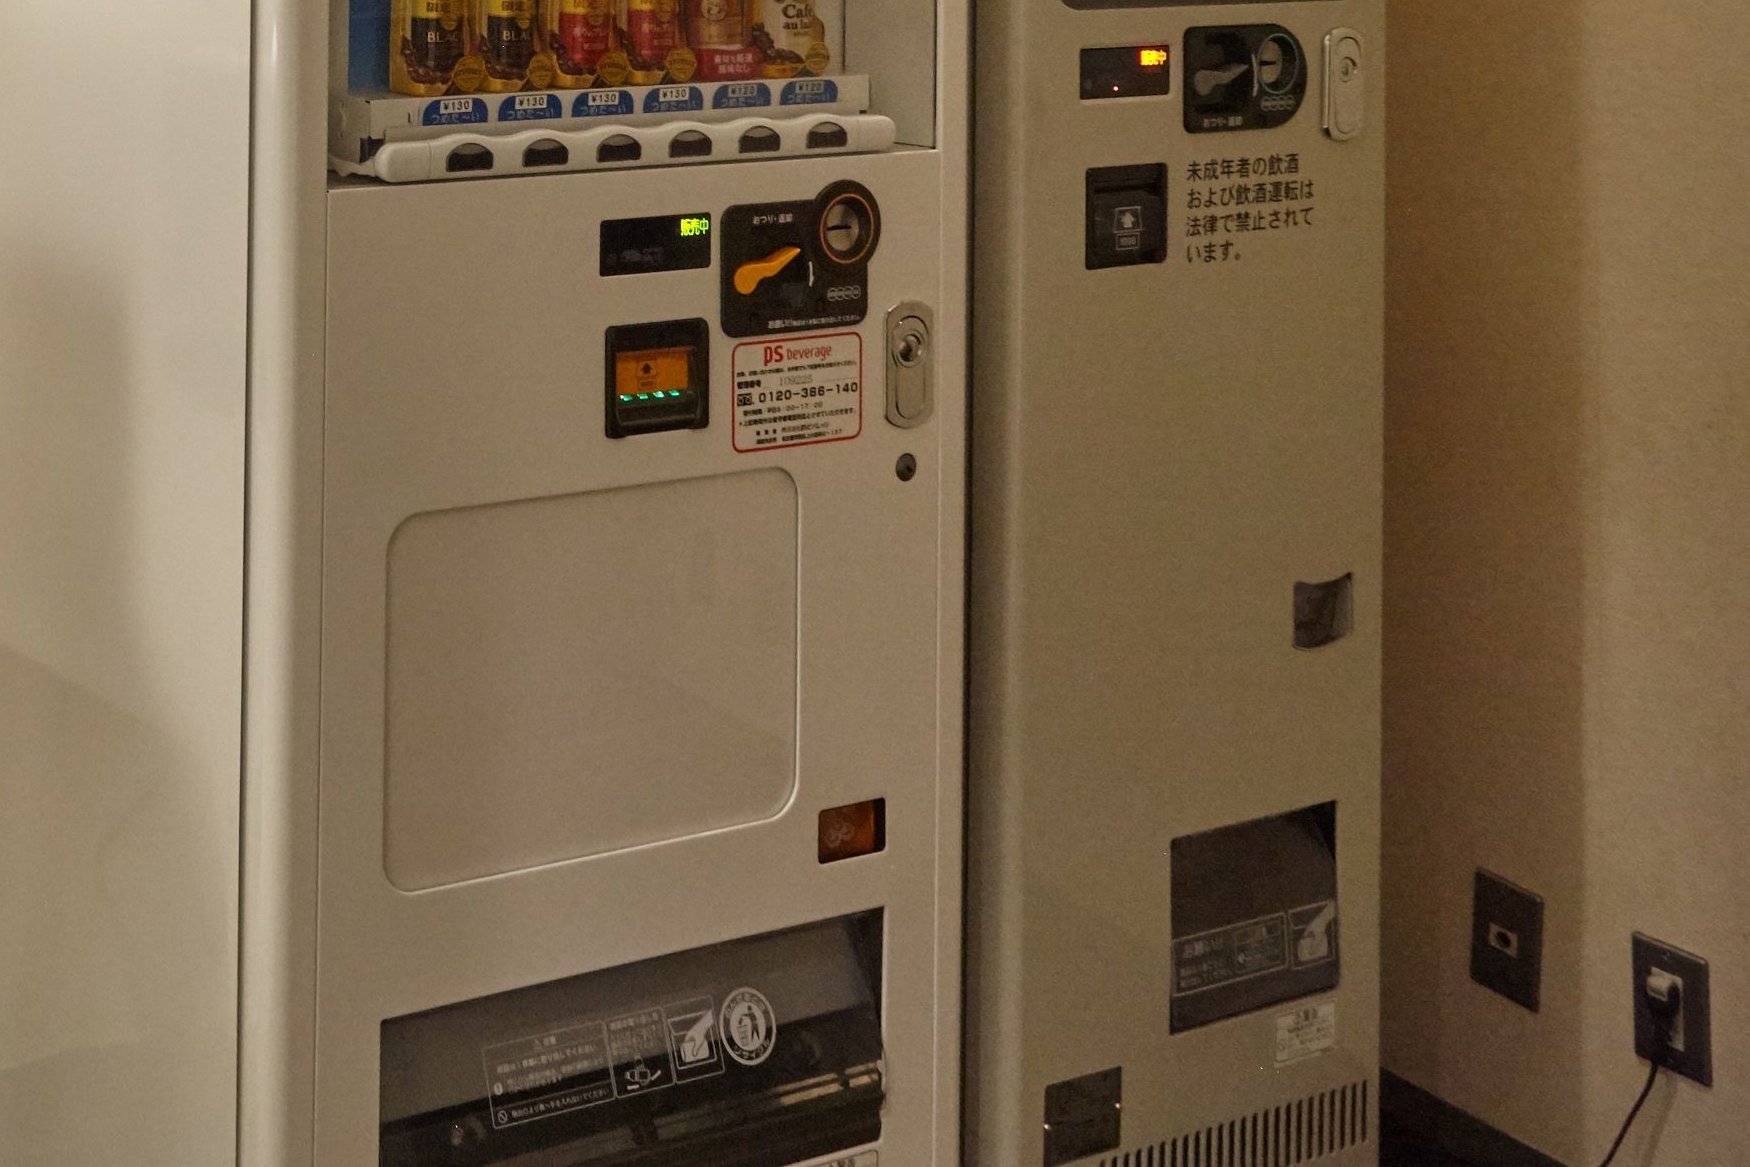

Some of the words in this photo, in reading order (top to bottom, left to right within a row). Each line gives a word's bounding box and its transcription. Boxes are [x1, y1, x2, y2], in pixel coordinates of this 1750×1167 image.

[518, 97, 545, 108] ¥130
[591, 93, 617, 103] ¥130
[662, 89, 687, 99] ¥130
[443, 101, 470, 112] ¥130
[1187, 153, 1298, 182] 未成年者の飲酒
[1187, 179, 1314, 209] および飲酒運転は
[1186, 207, 1314, 237] 法律で禁止されて
[1187, 240, 1241, 263] います。
[786, 345, 832, 361] beverage
[758, 382, 858, 403] 0120-386-140
